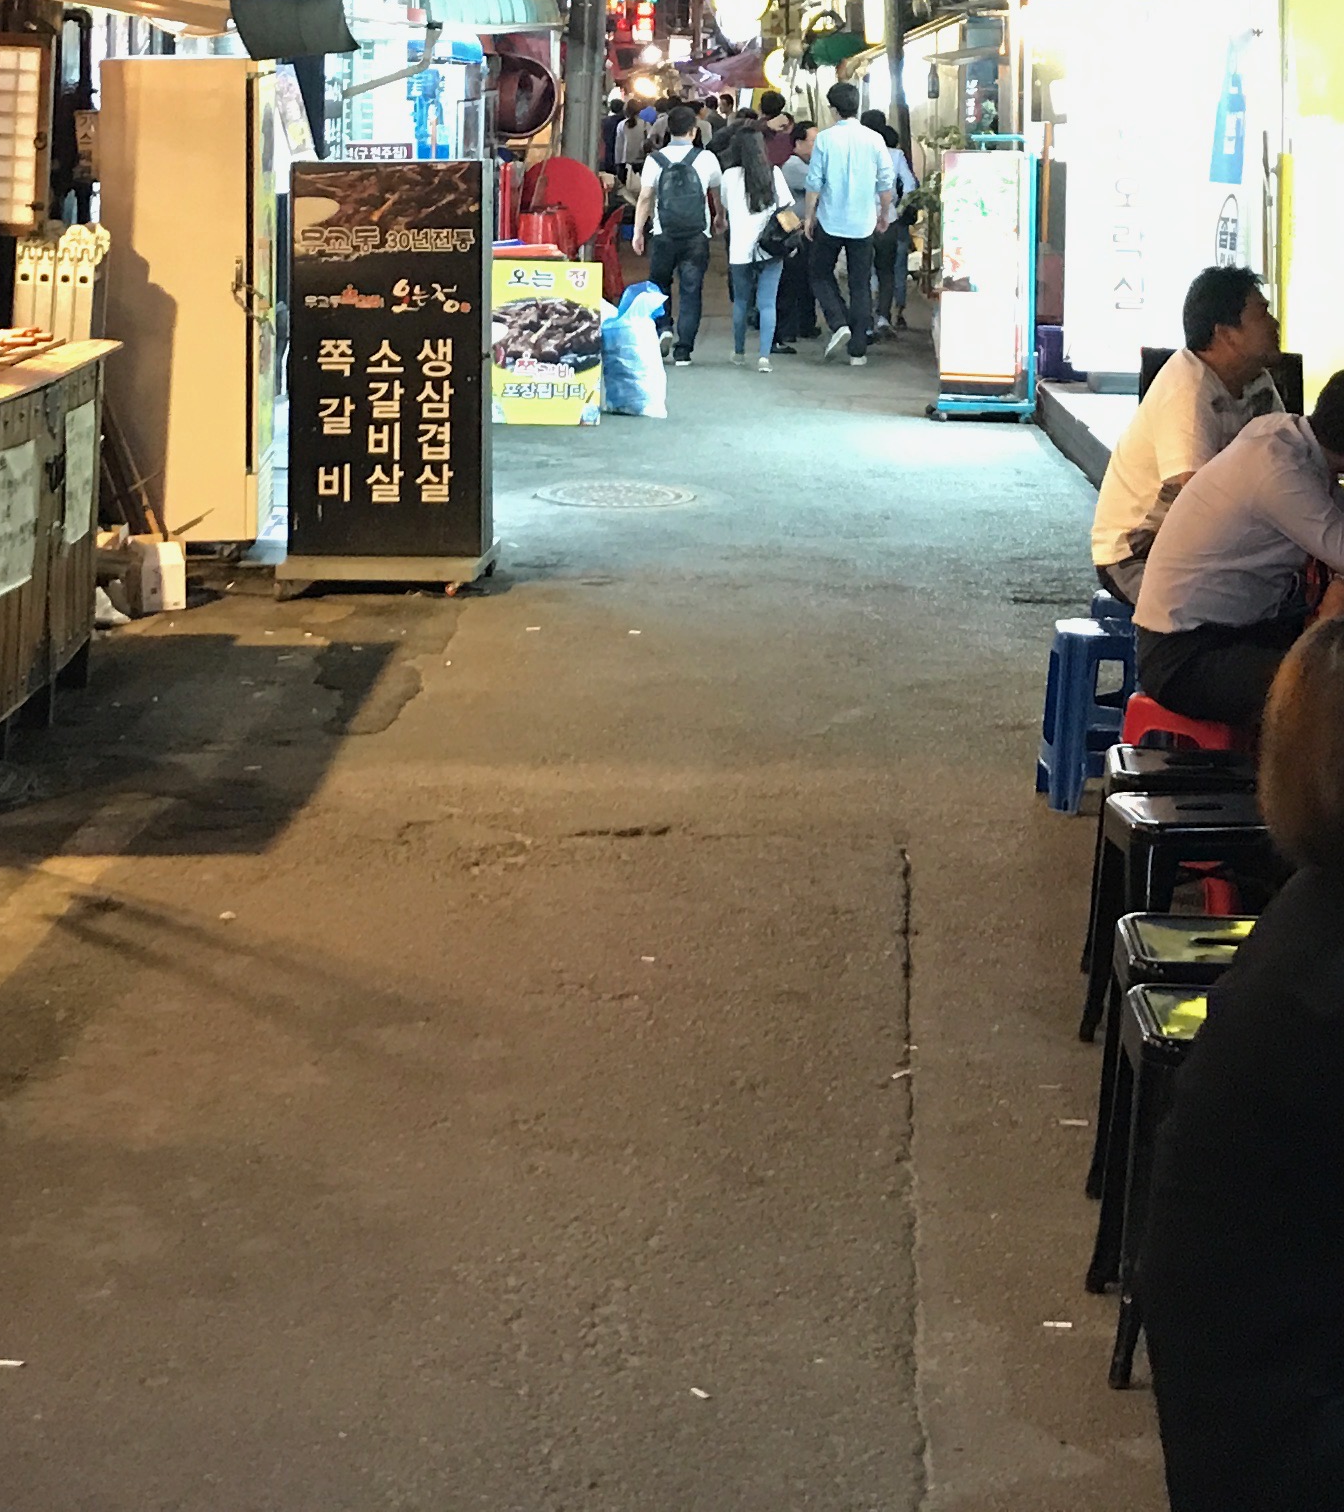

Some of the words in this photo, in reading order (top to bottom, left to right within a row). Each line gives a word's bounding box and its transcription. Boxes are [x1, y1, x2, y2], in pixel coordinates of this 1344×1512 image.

[300, 225, 381, 255] 무교동
[385, 227, 476, 253] 30년전통
[507, 268, 555, 289] 오는
[568, 269, 588, 289] 정
[316, 338, 356, 503] 쪽갈비
[365, 338, 407, 505] 소갈비살
[414, 337, 456, 505] 생삼겹살
